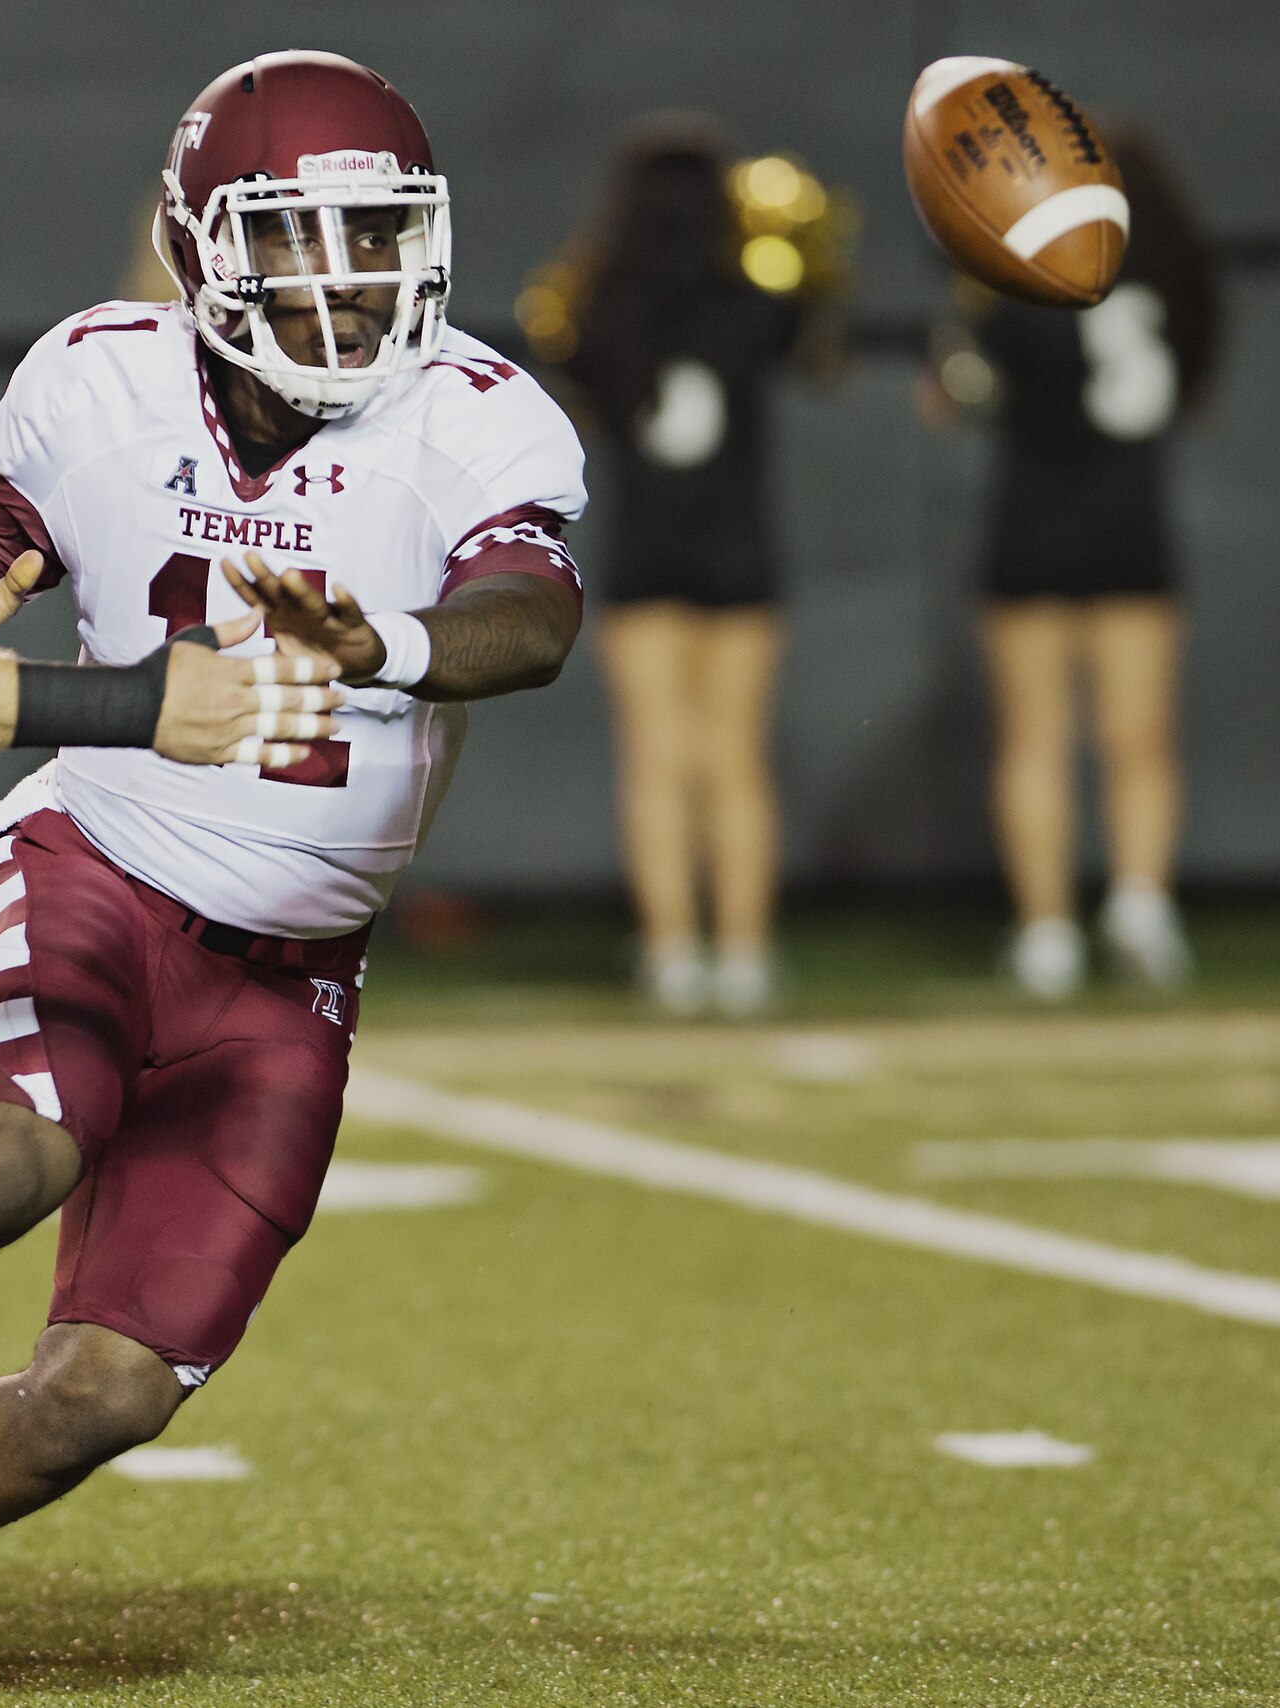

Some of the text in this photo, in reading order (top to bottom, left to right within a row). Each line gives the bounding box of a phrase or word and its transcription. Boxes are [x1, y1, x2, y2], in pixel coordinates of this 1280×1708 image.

[321, 156, 375, 172] Riddell
[163, 454, 199, 497] A
[178, 507, 313, 552] TEMPLE
